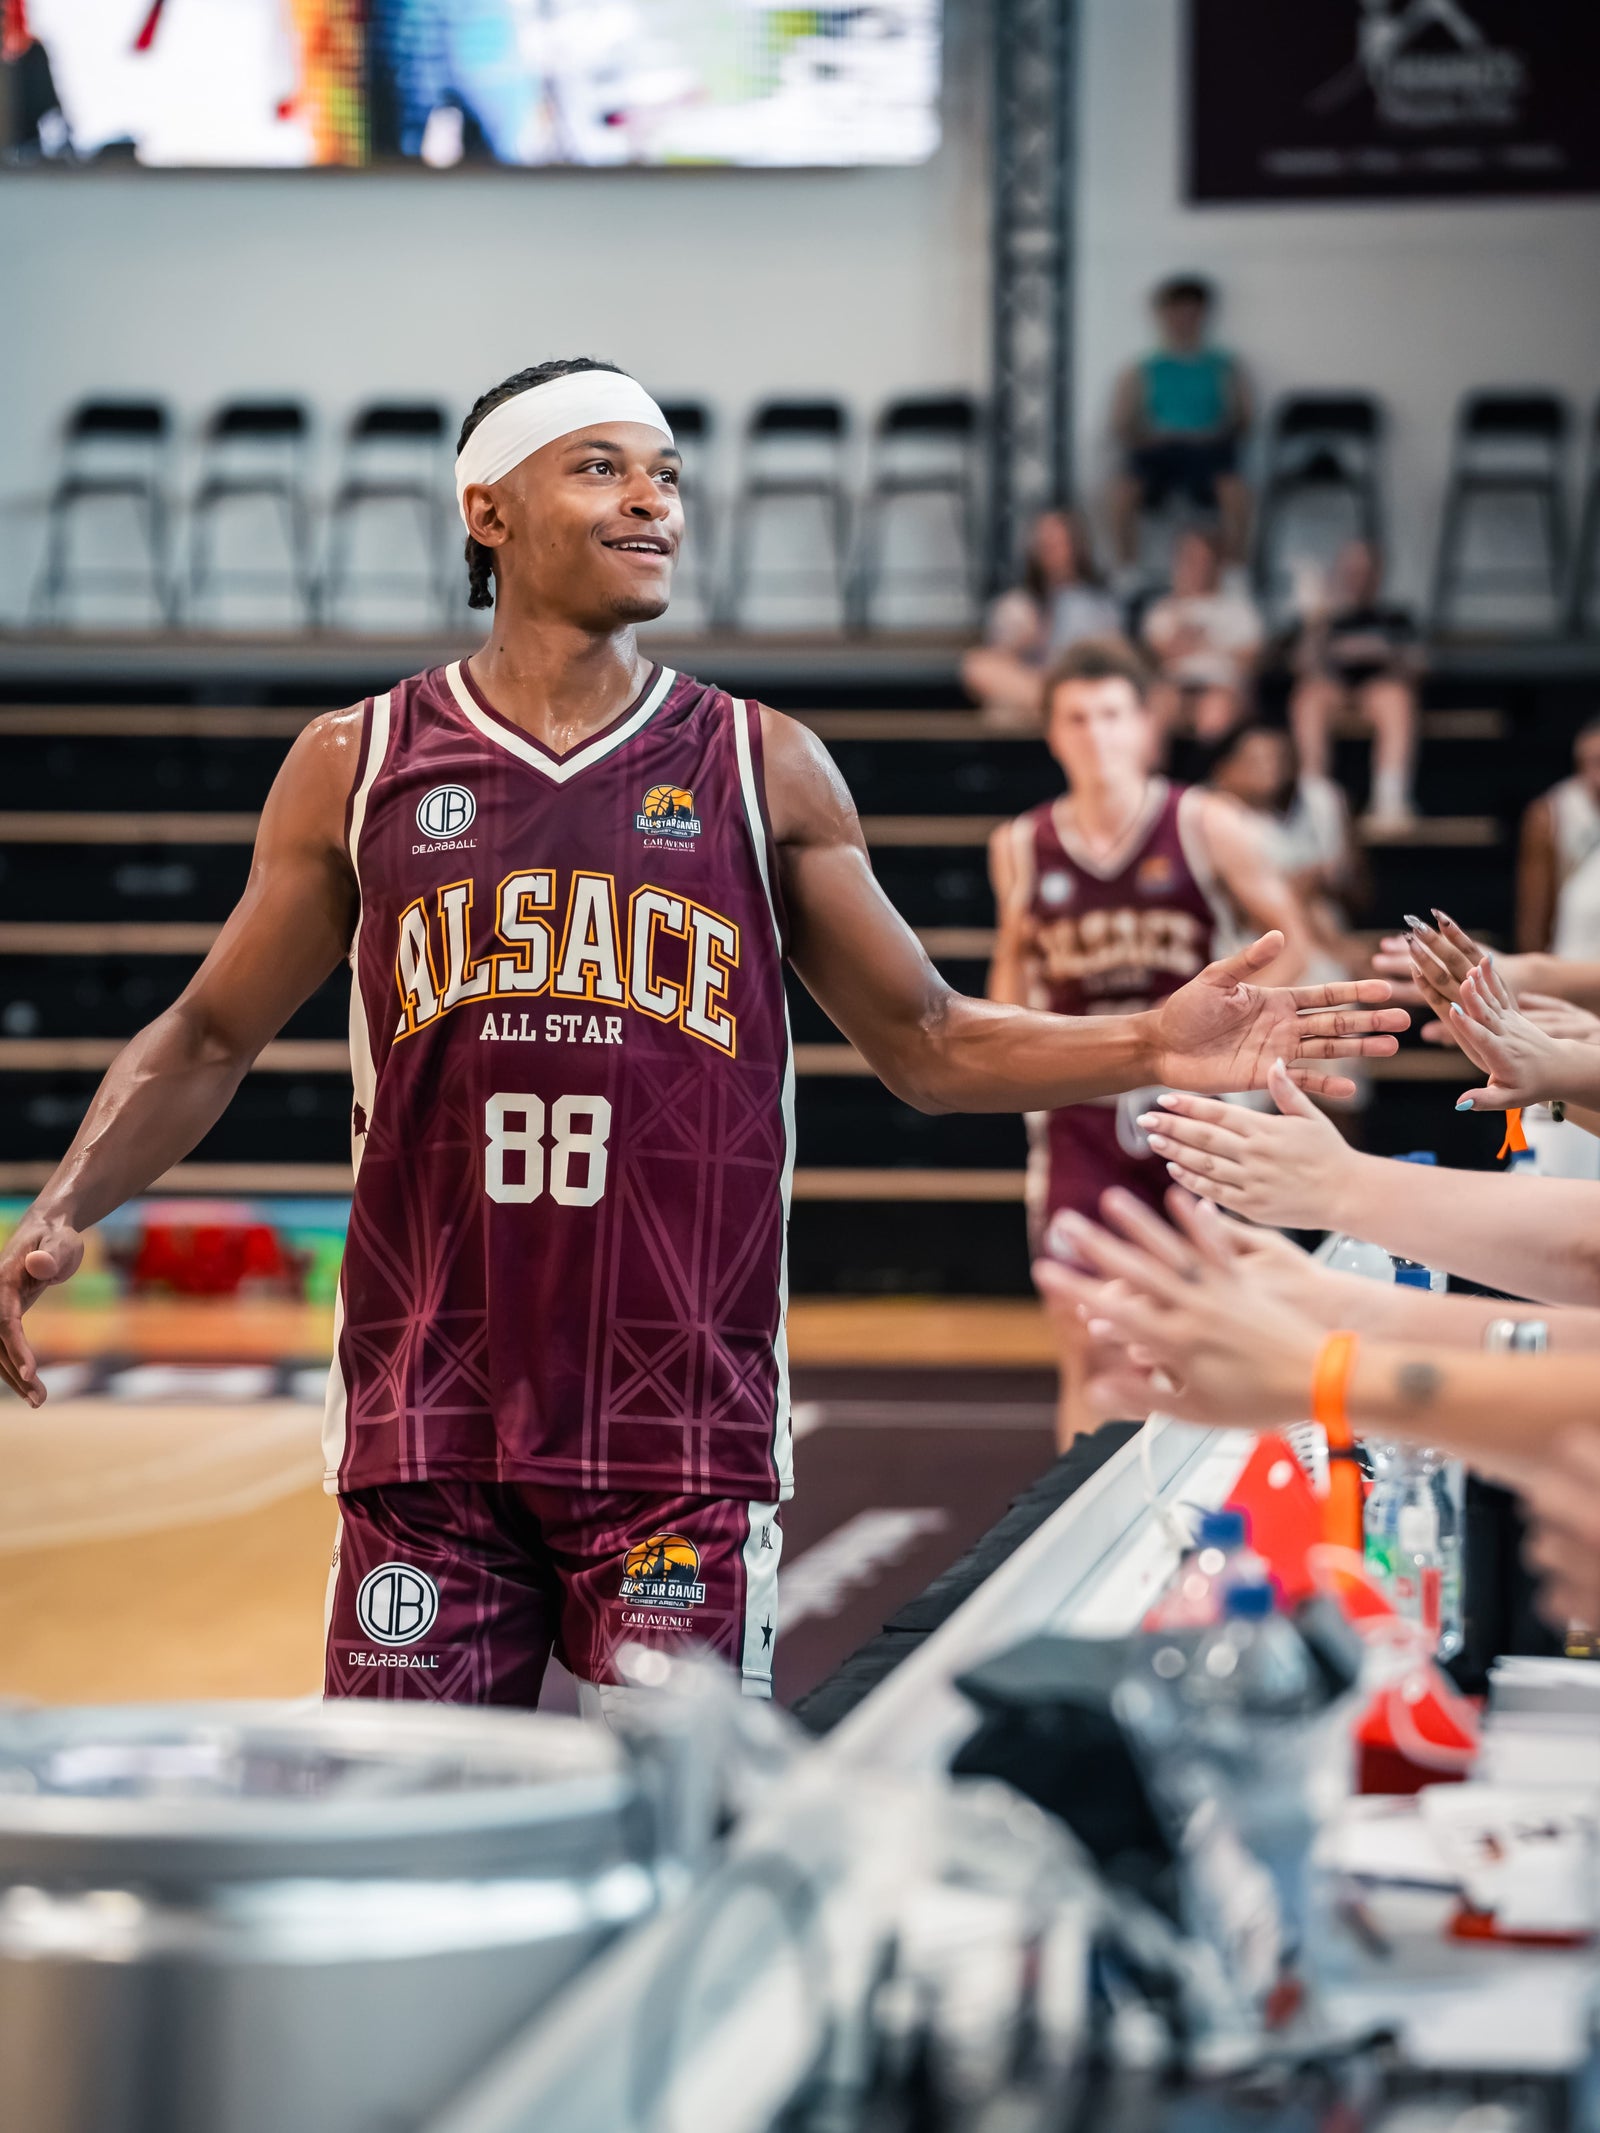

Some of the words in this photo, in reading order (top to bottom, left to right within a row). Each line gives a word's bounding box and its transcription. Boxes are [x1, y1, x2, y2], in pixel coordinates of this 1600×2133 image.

[640, 818, 653, 828] ALL
[655, 818, 677, 829] STAR
[677, 820, 699, 831] GAME
[412, 839, 477, 855] DEARBBALL
[643, 838, 663, 846] CAR
[664, 839, 696, 850] AVENUE
[392, 868, 741, 1059] ALSACE
[480, 1013, 536, 1042] ALL
[545, 1014, 623, 1044] STAR
[485, 1092, 612, 1207] 88
[621, 1580, 636, 1595] ALL
[637, 1582, 666, 1597] STAR
[667, 1584, 702, 1599] GAME
[621, 1611, 645, 1624] CAR
[646, 1613, 693, 1628] AVENUE
[348, 1652, 439, 1668] DEARBBALL
